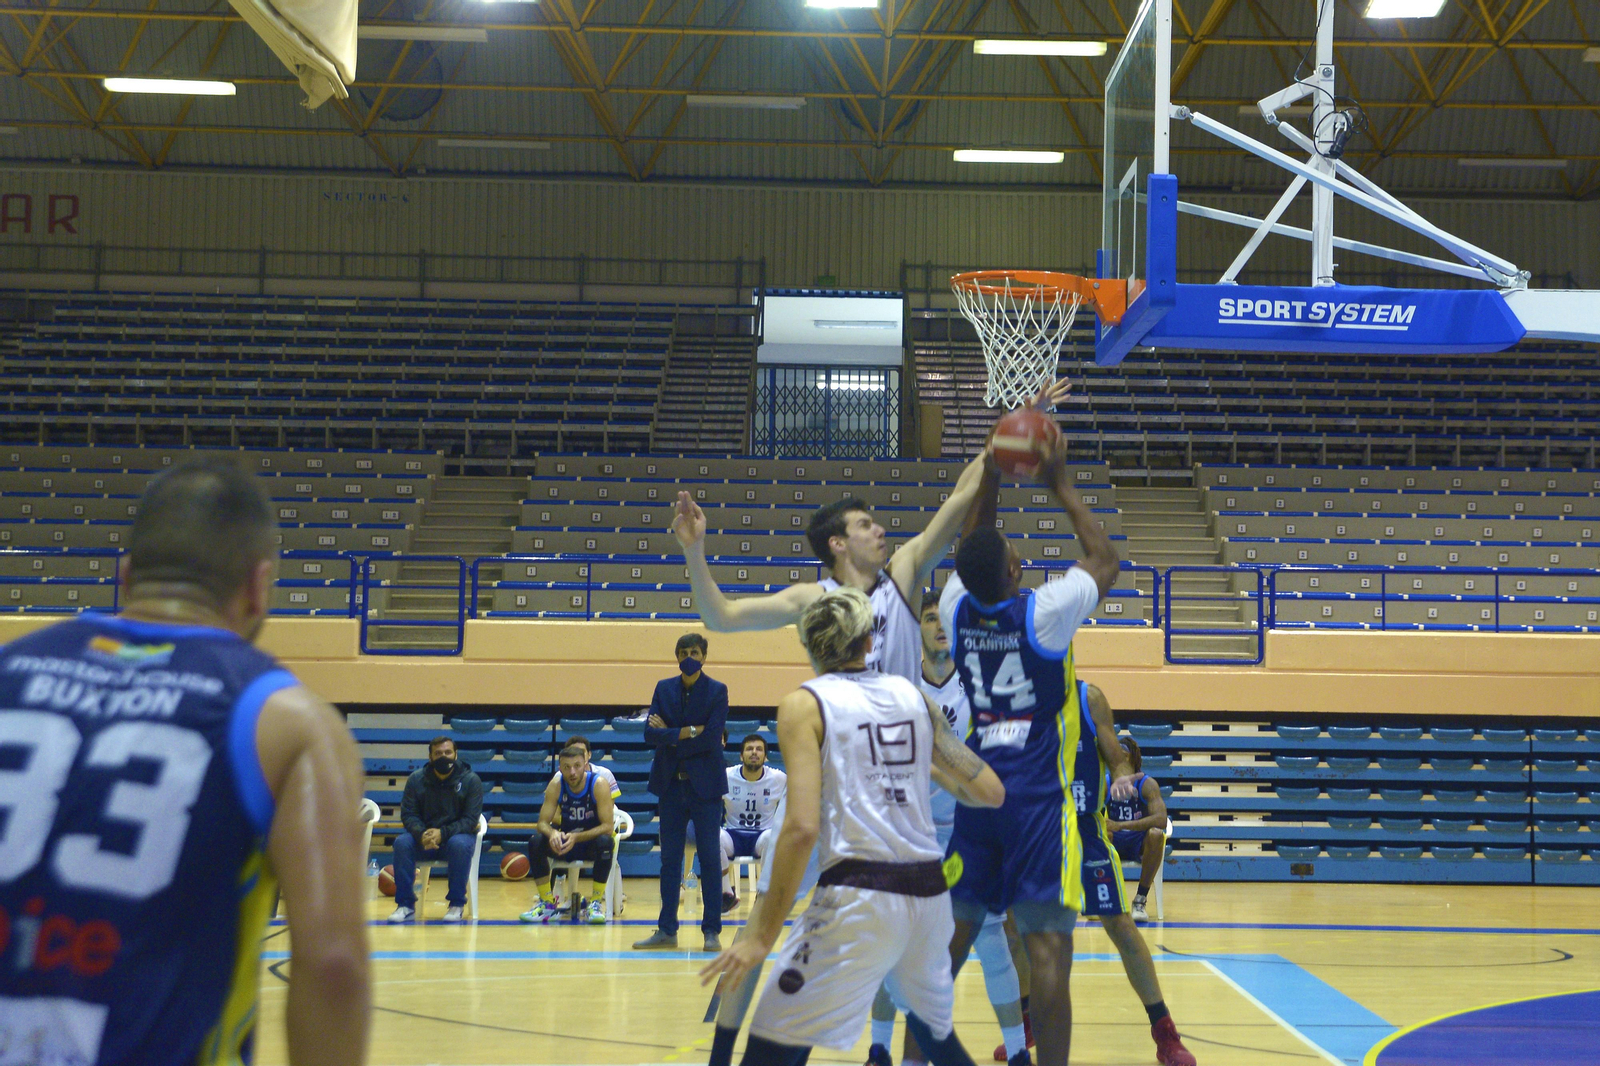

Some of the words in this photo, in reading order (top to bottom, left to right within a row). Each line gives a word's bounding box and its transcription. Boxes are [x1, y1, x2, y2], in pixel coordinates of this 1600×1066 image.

[1219, 298, 1307, 320] SPORT
[1308, 301, 1417, 328] SYSTEM
[964, 651, 1037, 712] 14
[857, 719, 916, 766] 19
[569, 807, 586, 821] 30
[745, 799, 756, 812] 11
[1118, 806, 1132, 821] 13
[1097, 884, 1110, 901] 8
